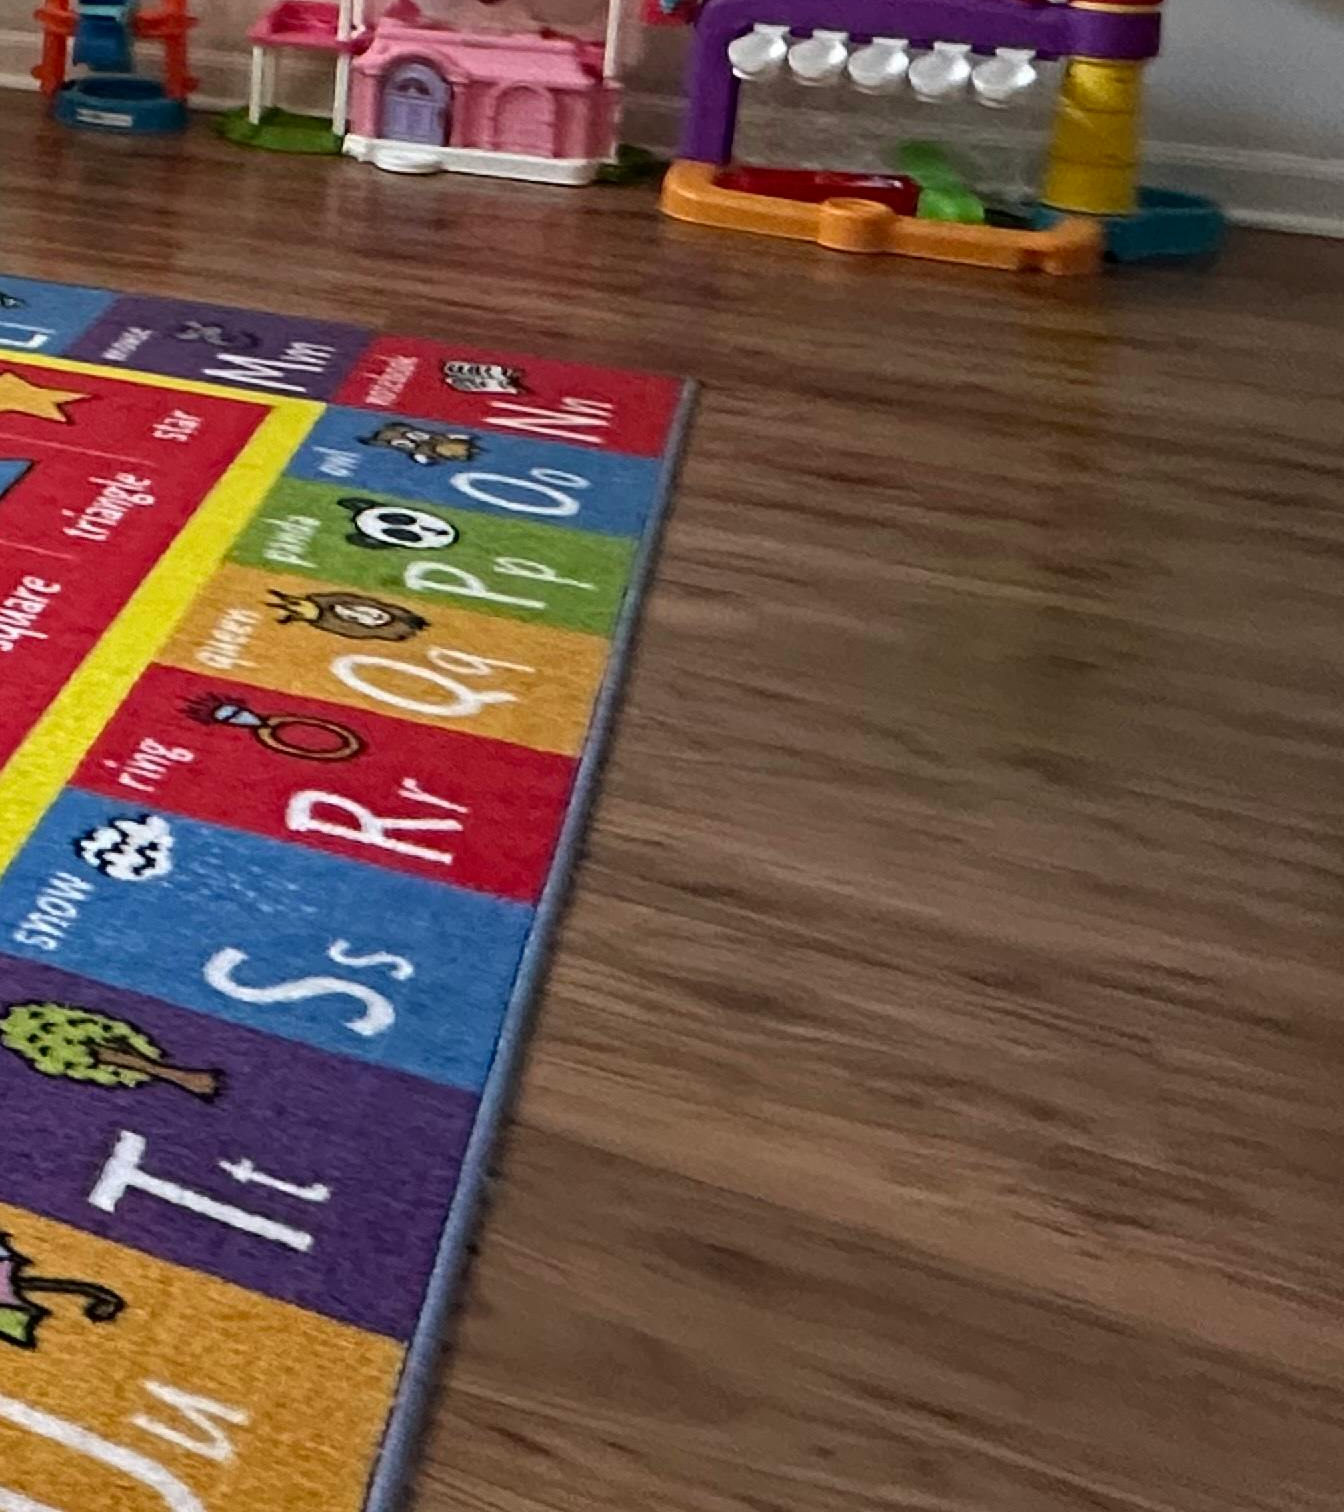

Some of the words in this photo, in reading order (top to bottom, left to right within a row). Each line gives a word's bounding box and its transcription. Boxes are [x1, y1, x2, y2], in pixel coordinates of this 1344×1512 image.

[203, 341, 336, 393] Mm
[153, 408, 204, 443] star
[482, 396, 615, 443] Nn
[62, 472, 156, 542] triangle
[450, 467, 591, 516] Oo
[404, 555, 598, 610] Pp
[196, 607, 264, 670] queen
[330, 645, 536, 717] Qq
[103, 736, 196, 793] ring
[285, 776, 471, 866] Rr
[13, 870, 96, 953] snow
[202, 936, 416, 1038] Ss
[87, 1129, 332, 1252] Tt
